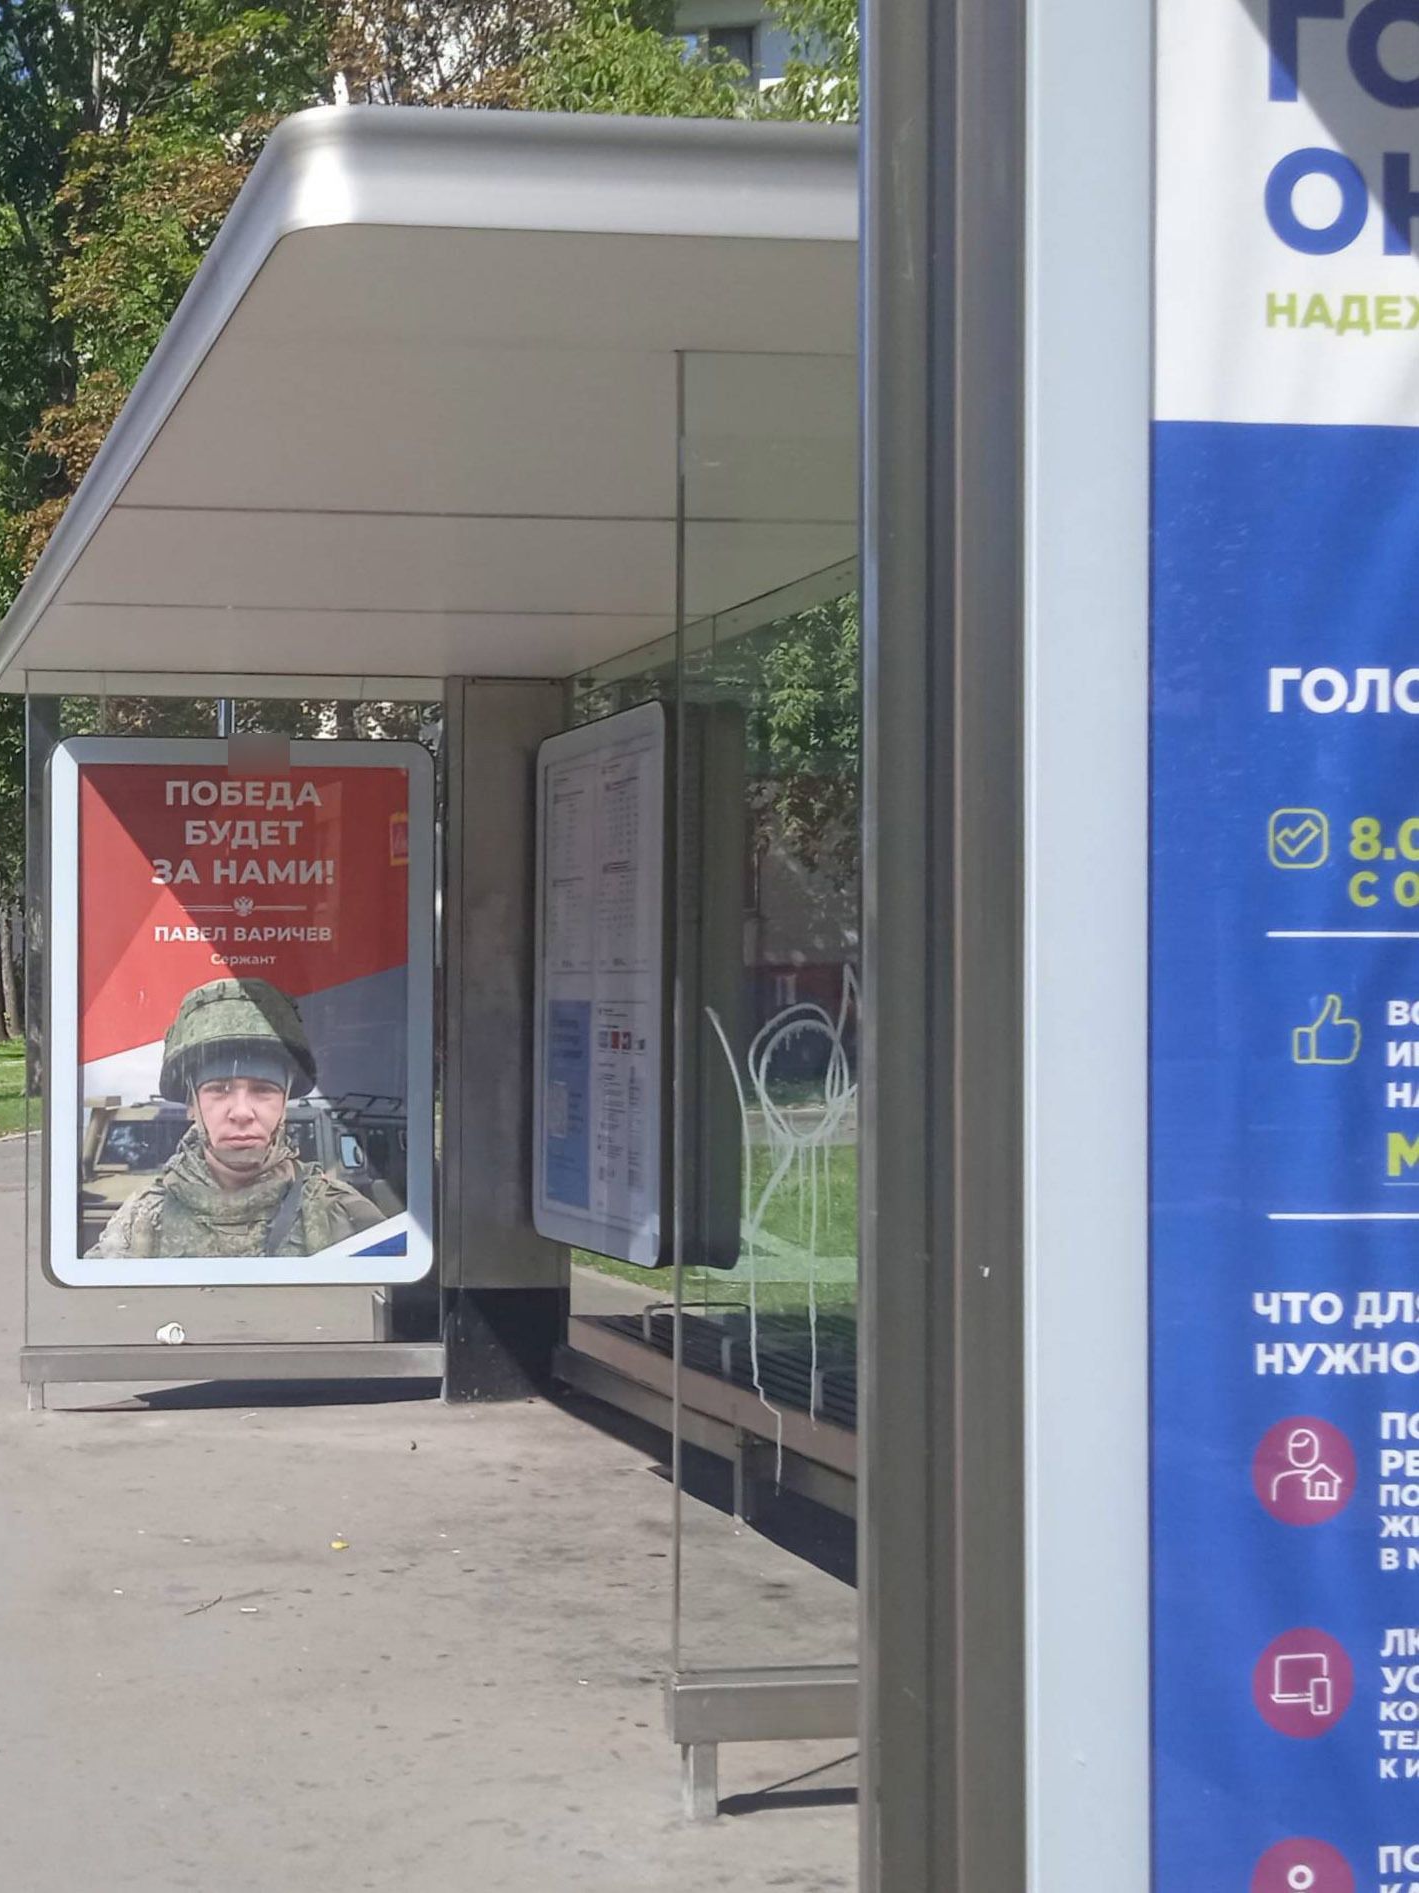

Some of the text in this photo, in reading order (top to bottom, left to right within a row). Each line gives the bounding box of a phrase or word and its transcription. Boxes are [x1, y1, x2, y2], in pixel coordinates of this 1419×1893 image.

[165, 781, 322, 811] ПОБЕДА
[185, 821, 304, 850] БУДЕТ
[151, 859, 335, 885] ЗА НАМИ!
[154, 926, 332, 942] ПАВЕЛ ВАРИЧЕВ
[210, 953, 276, 968] Сержант
[1253, 1292, 1419, 1329] ЧТО ДЛ
[1255, 1342, 1419, 1375] НУЖНО
